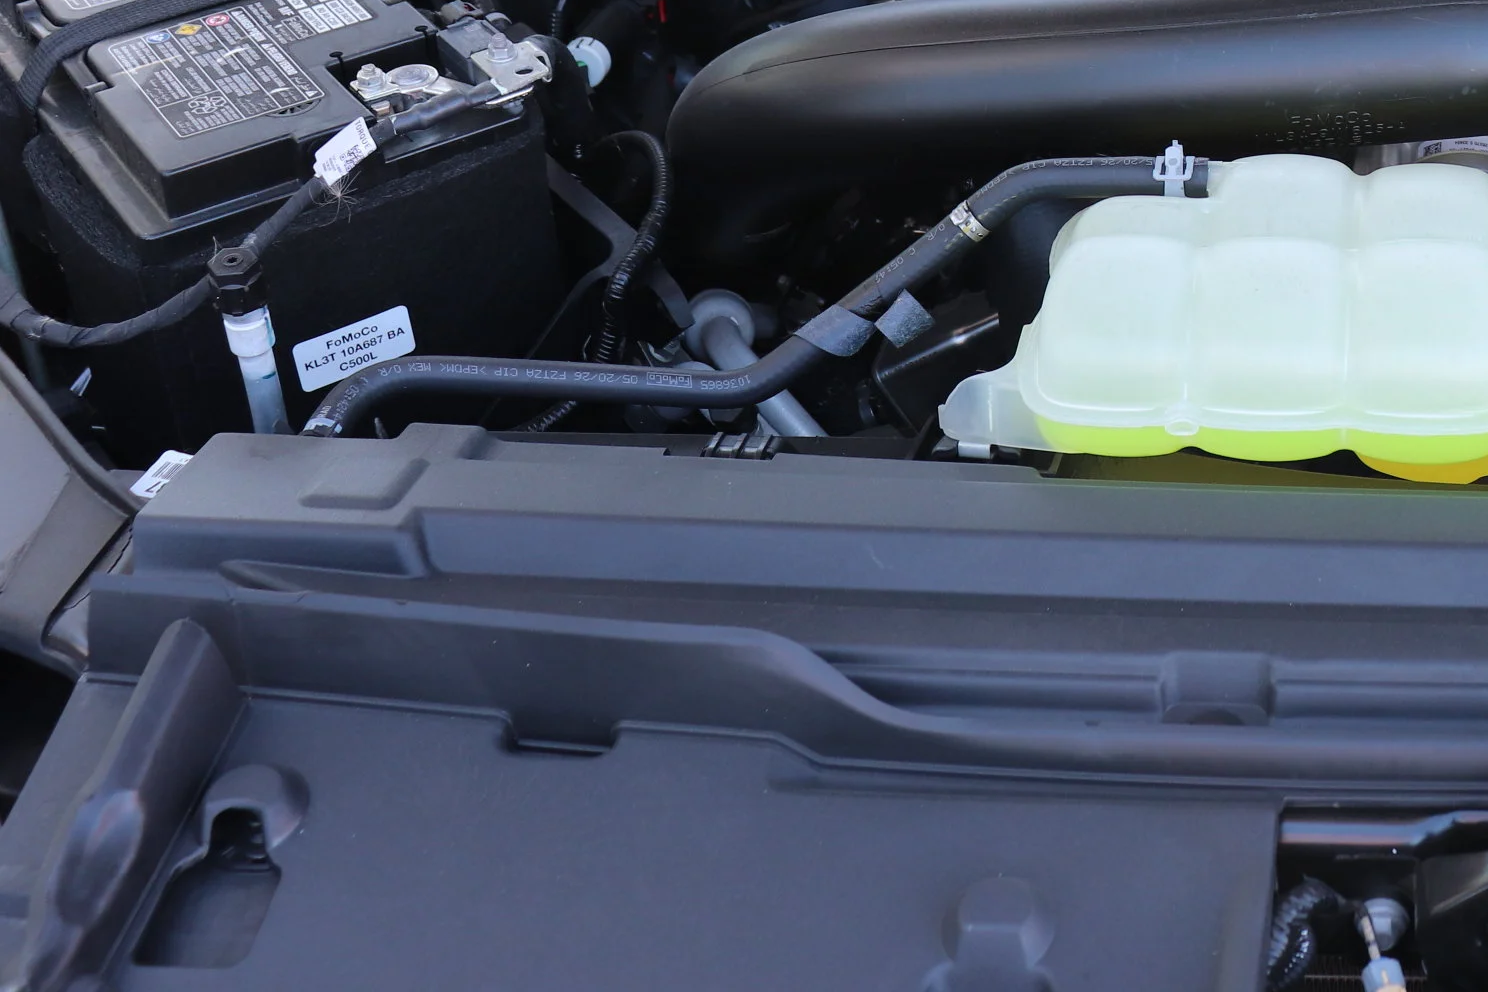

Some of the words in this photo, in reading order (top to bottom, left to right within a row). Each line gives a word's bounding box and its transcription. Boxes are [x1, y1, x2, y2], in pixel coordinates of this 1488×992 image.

[355, 119, 371, 149] TORQUE
[1100, 157, 1152, 165] 5/20/26
[326, 324, 378, 350] FoMoCo
[304, 352, 337, 371] KL3T
[341, 335, 383, 357] 10A687
[388, 327, 405, 339] BA
[339, 354, 378, 371] C500L
[493, 366, 518, 376] CIP
[573, 371, 638, 384] 05/20/26
[647, 372, 690, 385] FoMoCo
[699, 374, 750, 389] 1036865
